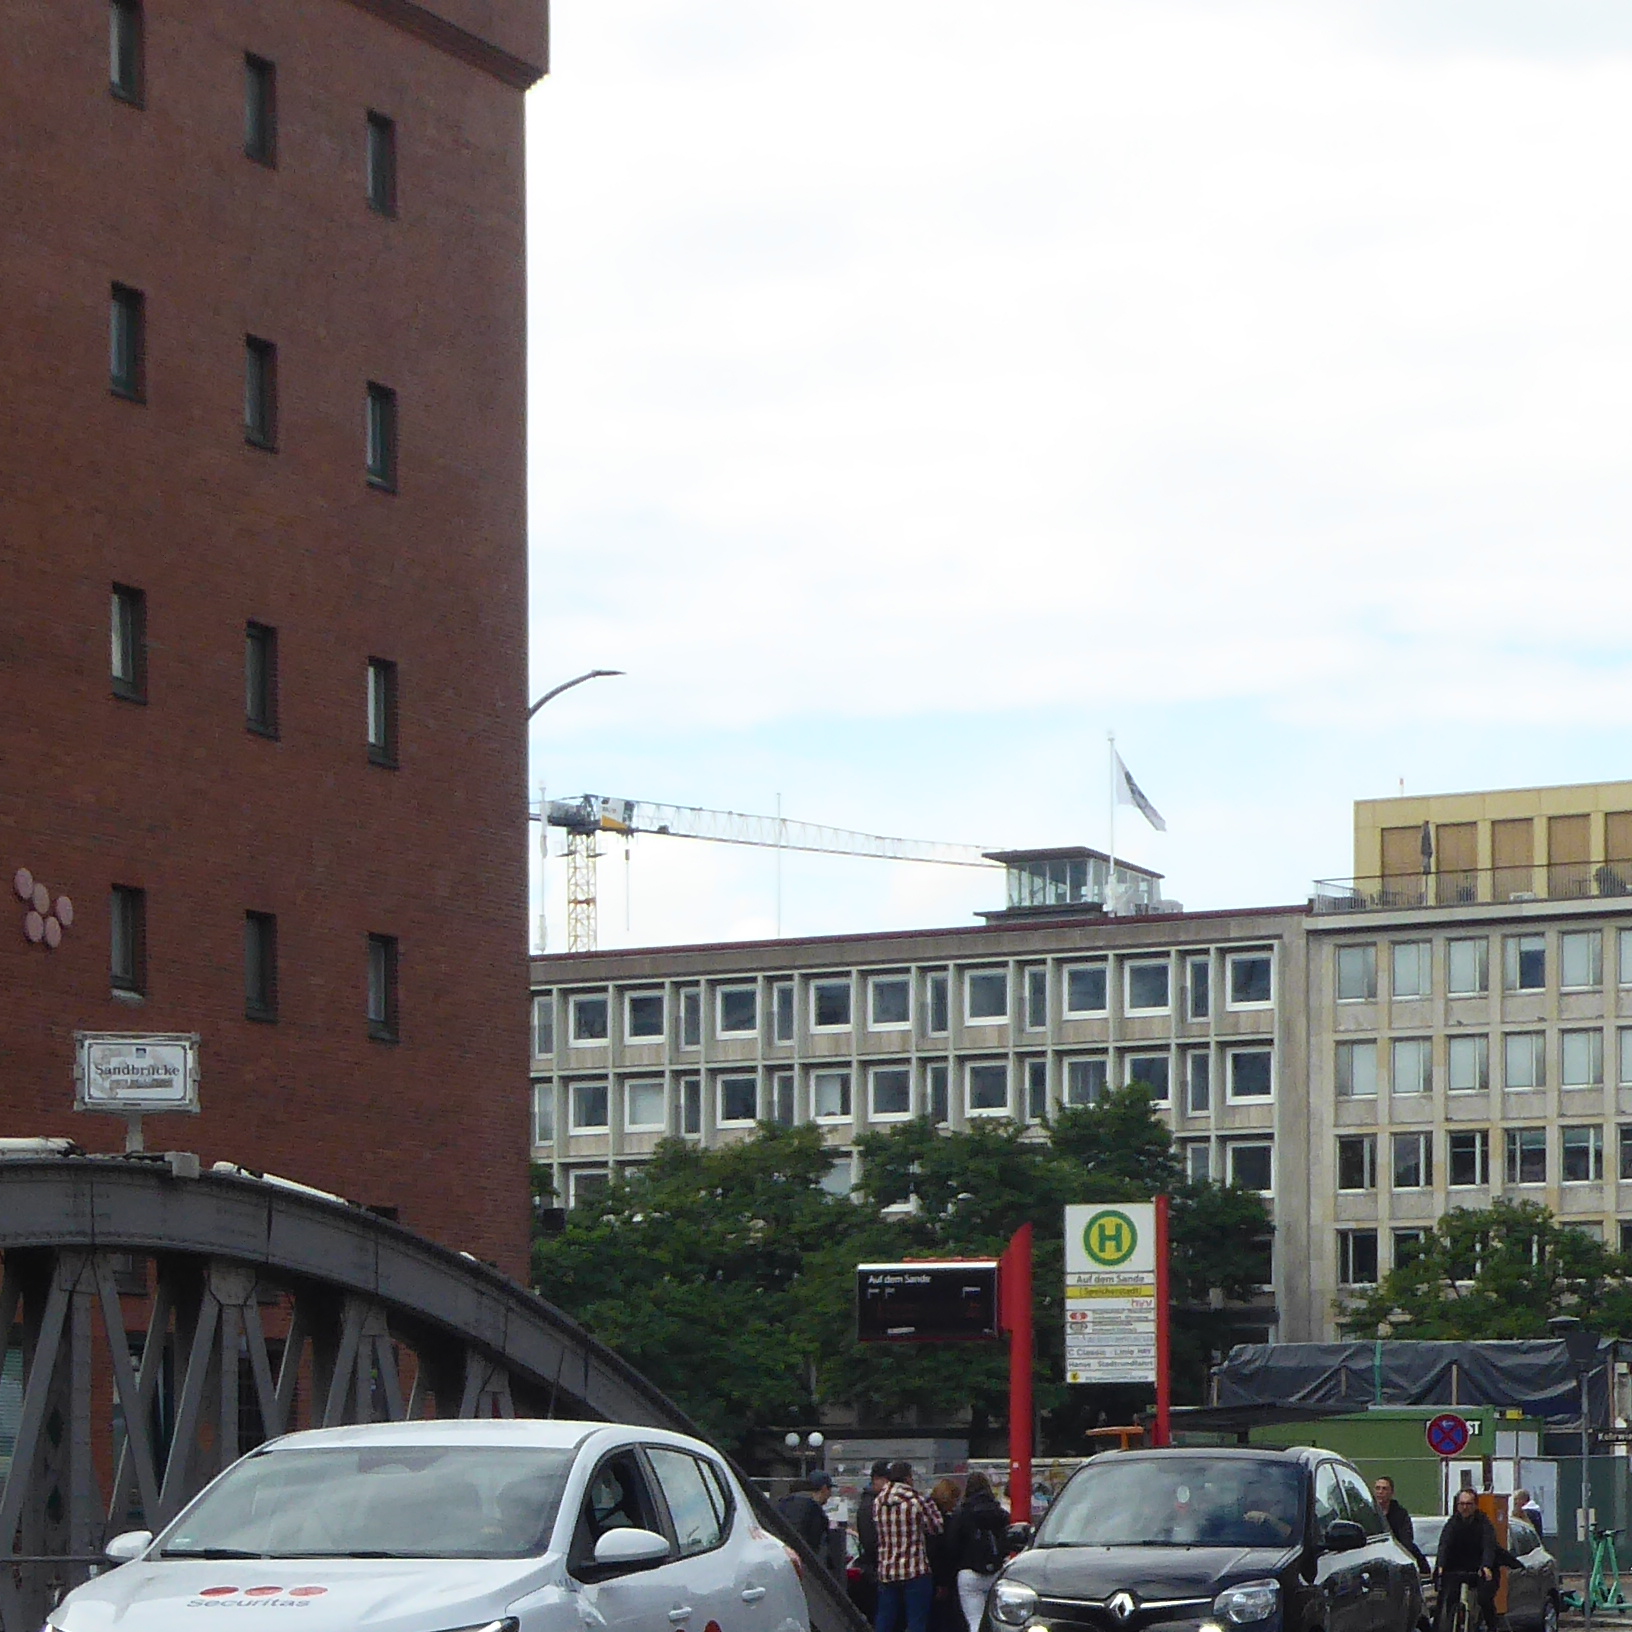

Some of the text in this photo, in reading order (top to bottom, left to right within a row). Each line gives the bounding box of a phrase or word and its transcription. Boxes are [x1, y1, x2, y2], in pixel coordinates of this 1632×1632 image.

[1098, 1223, 1123, 1252] H
[1076, 1275, 1145, 1284] Auf dem Sande
[186, 1599, 311, 1608] Securitas
